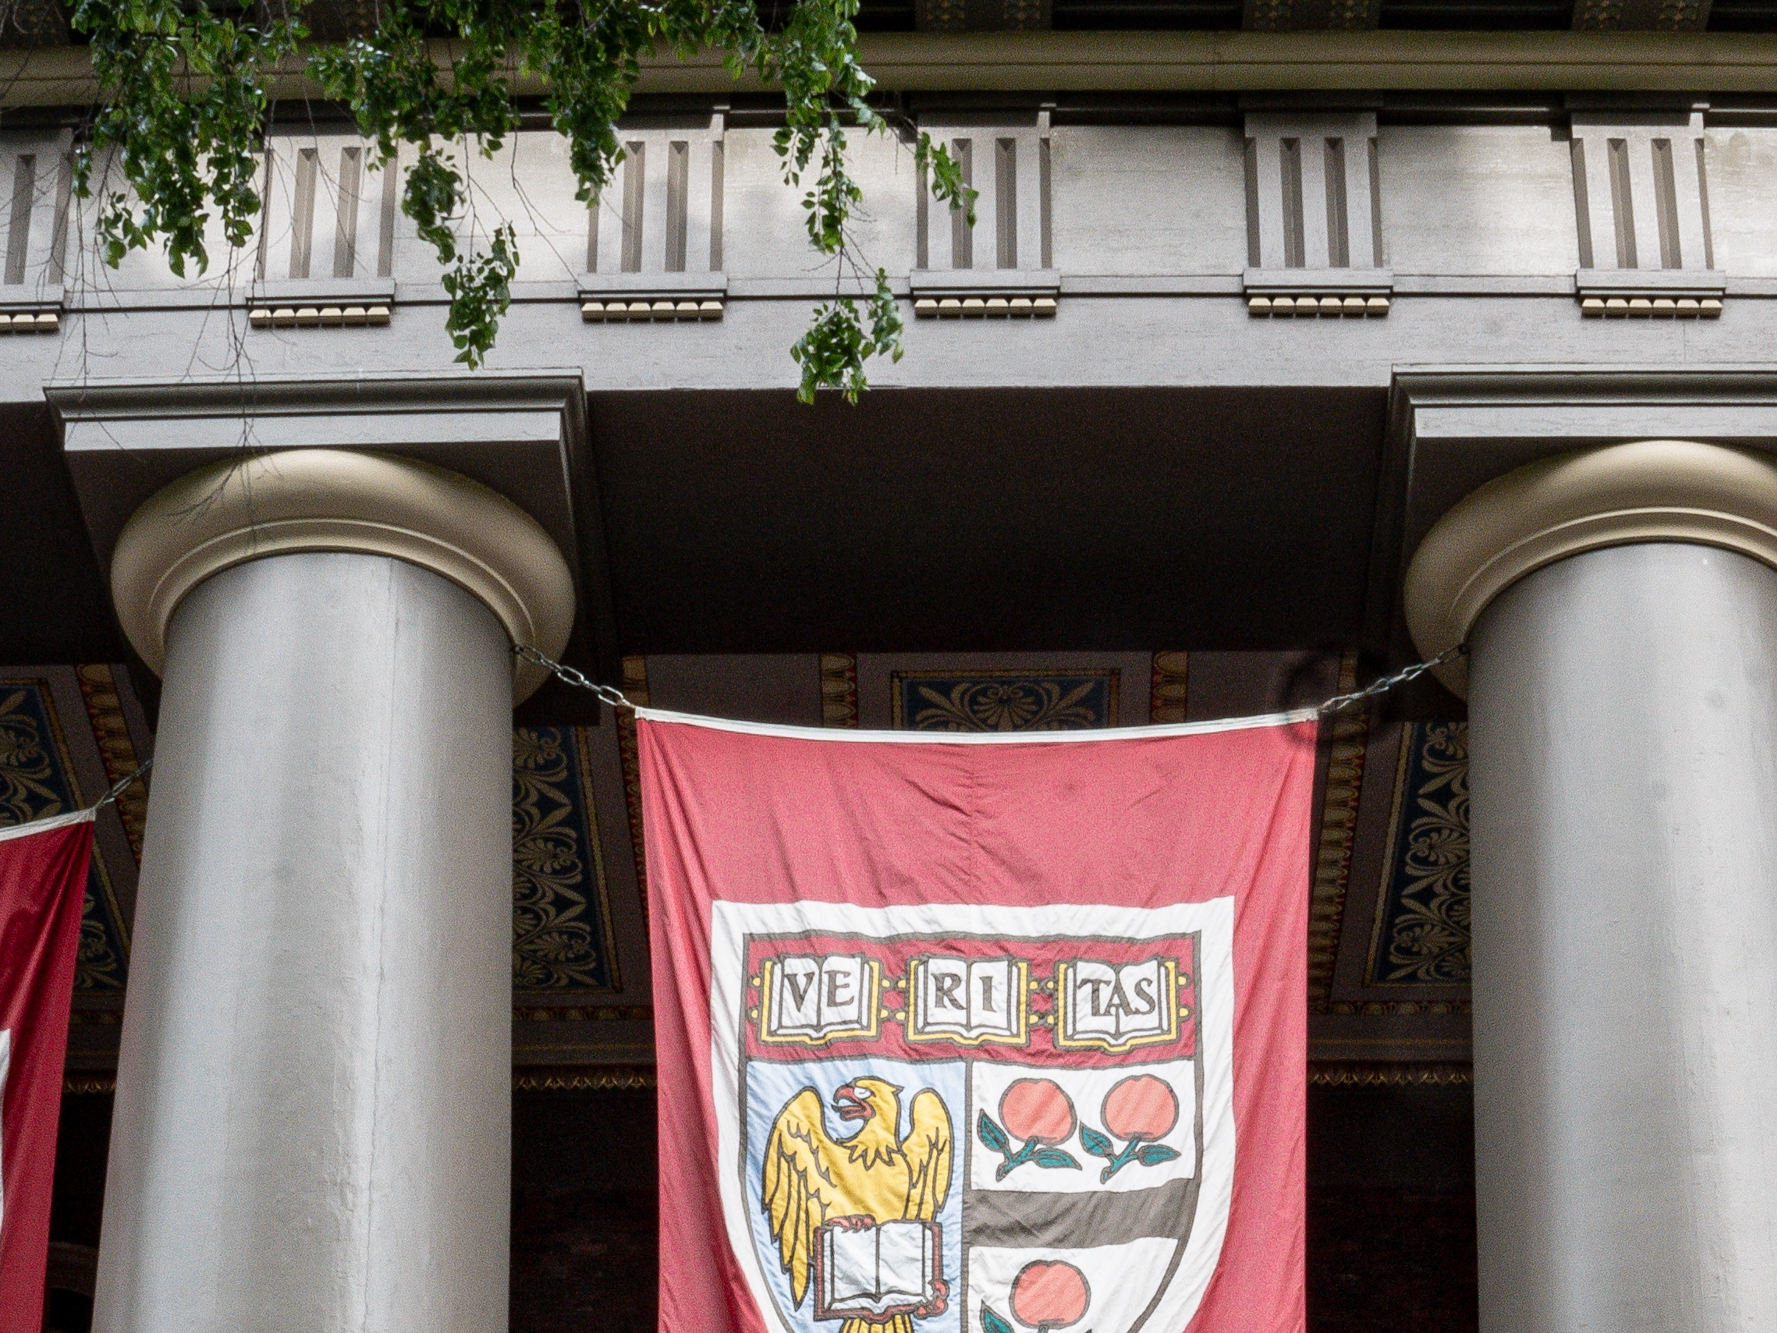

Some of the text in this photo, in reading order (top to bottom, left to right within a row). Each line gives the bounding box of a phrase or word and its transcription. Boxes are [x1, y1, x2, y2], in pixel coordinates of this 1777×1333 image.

[783, 969, 1158, 1017] VE RI TAS
